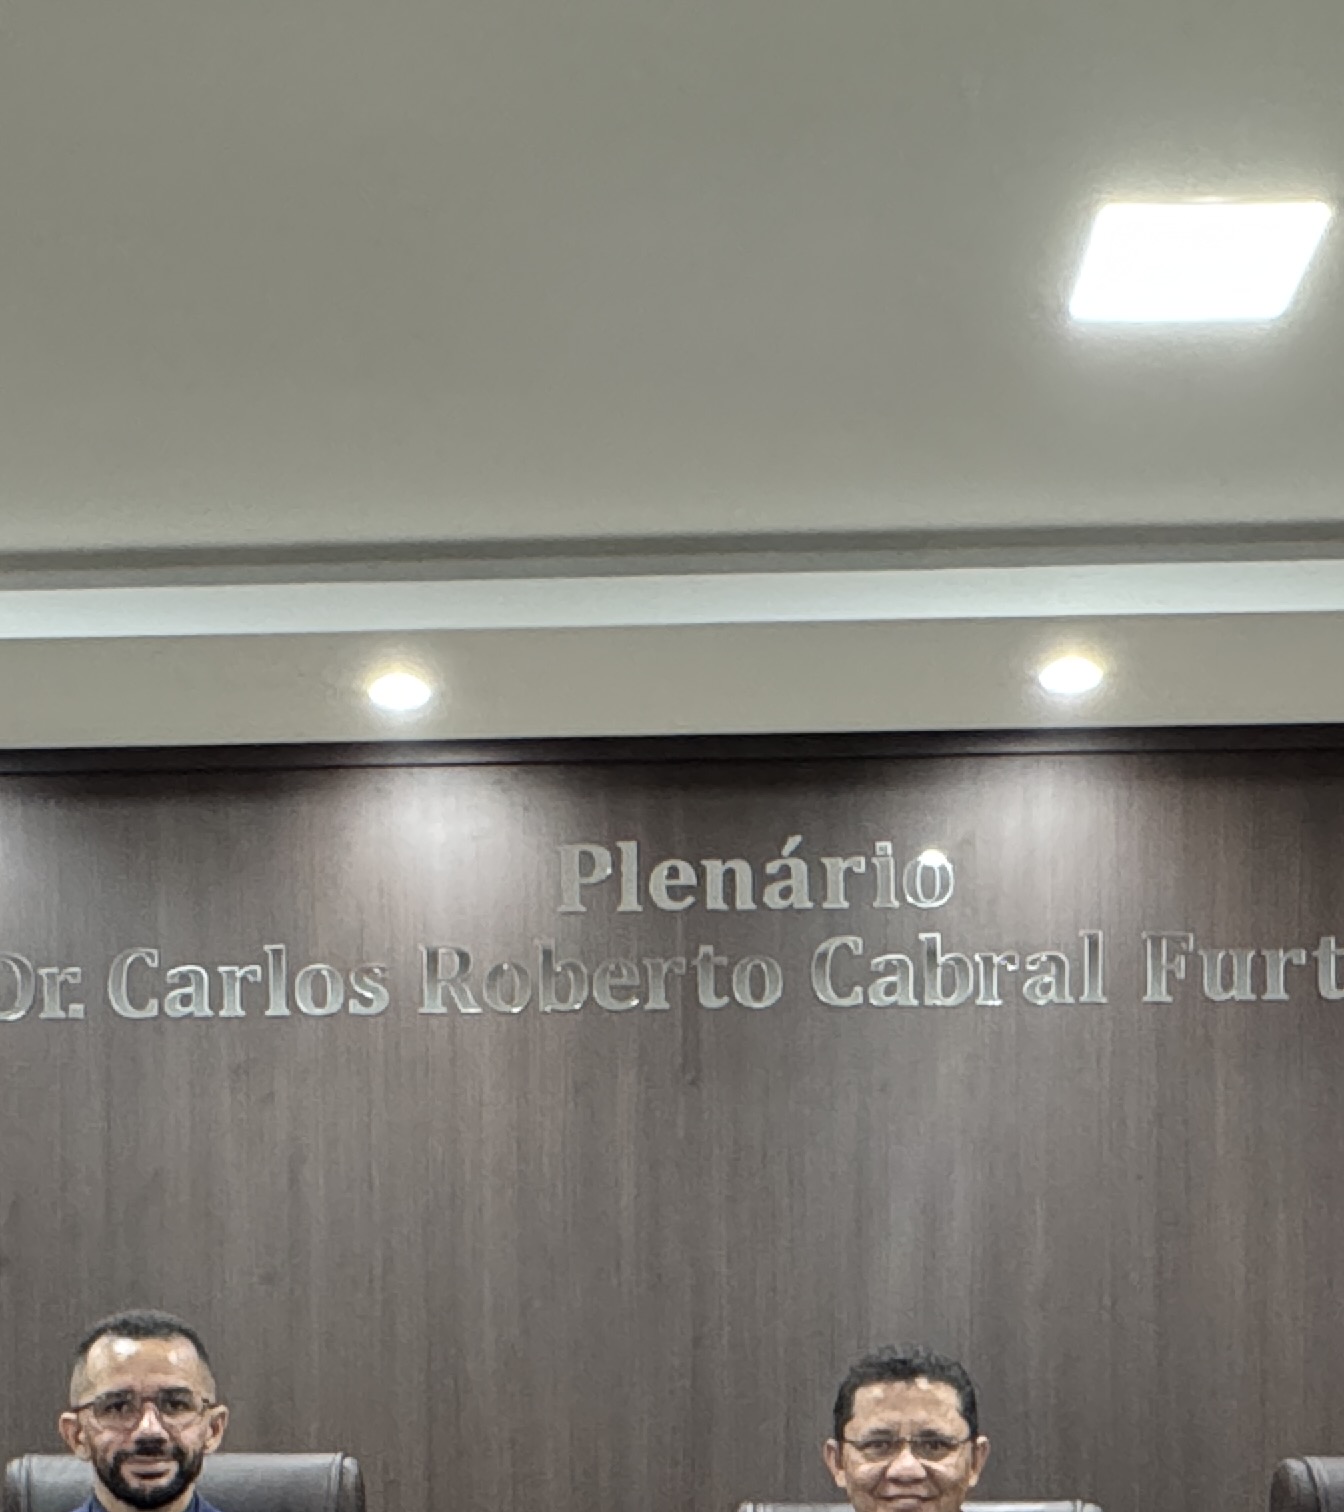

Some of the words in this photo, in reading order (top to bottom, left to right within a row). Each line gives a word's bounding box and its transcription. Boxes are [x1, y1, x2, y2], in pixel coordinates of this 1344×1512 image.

[557, 836, 956, 914] Plenário
[106, 943, 390, 1019] Carlos
[418, 937, 785, 1014] Roberto
[809, 930, 1109, 1007] Cabral
